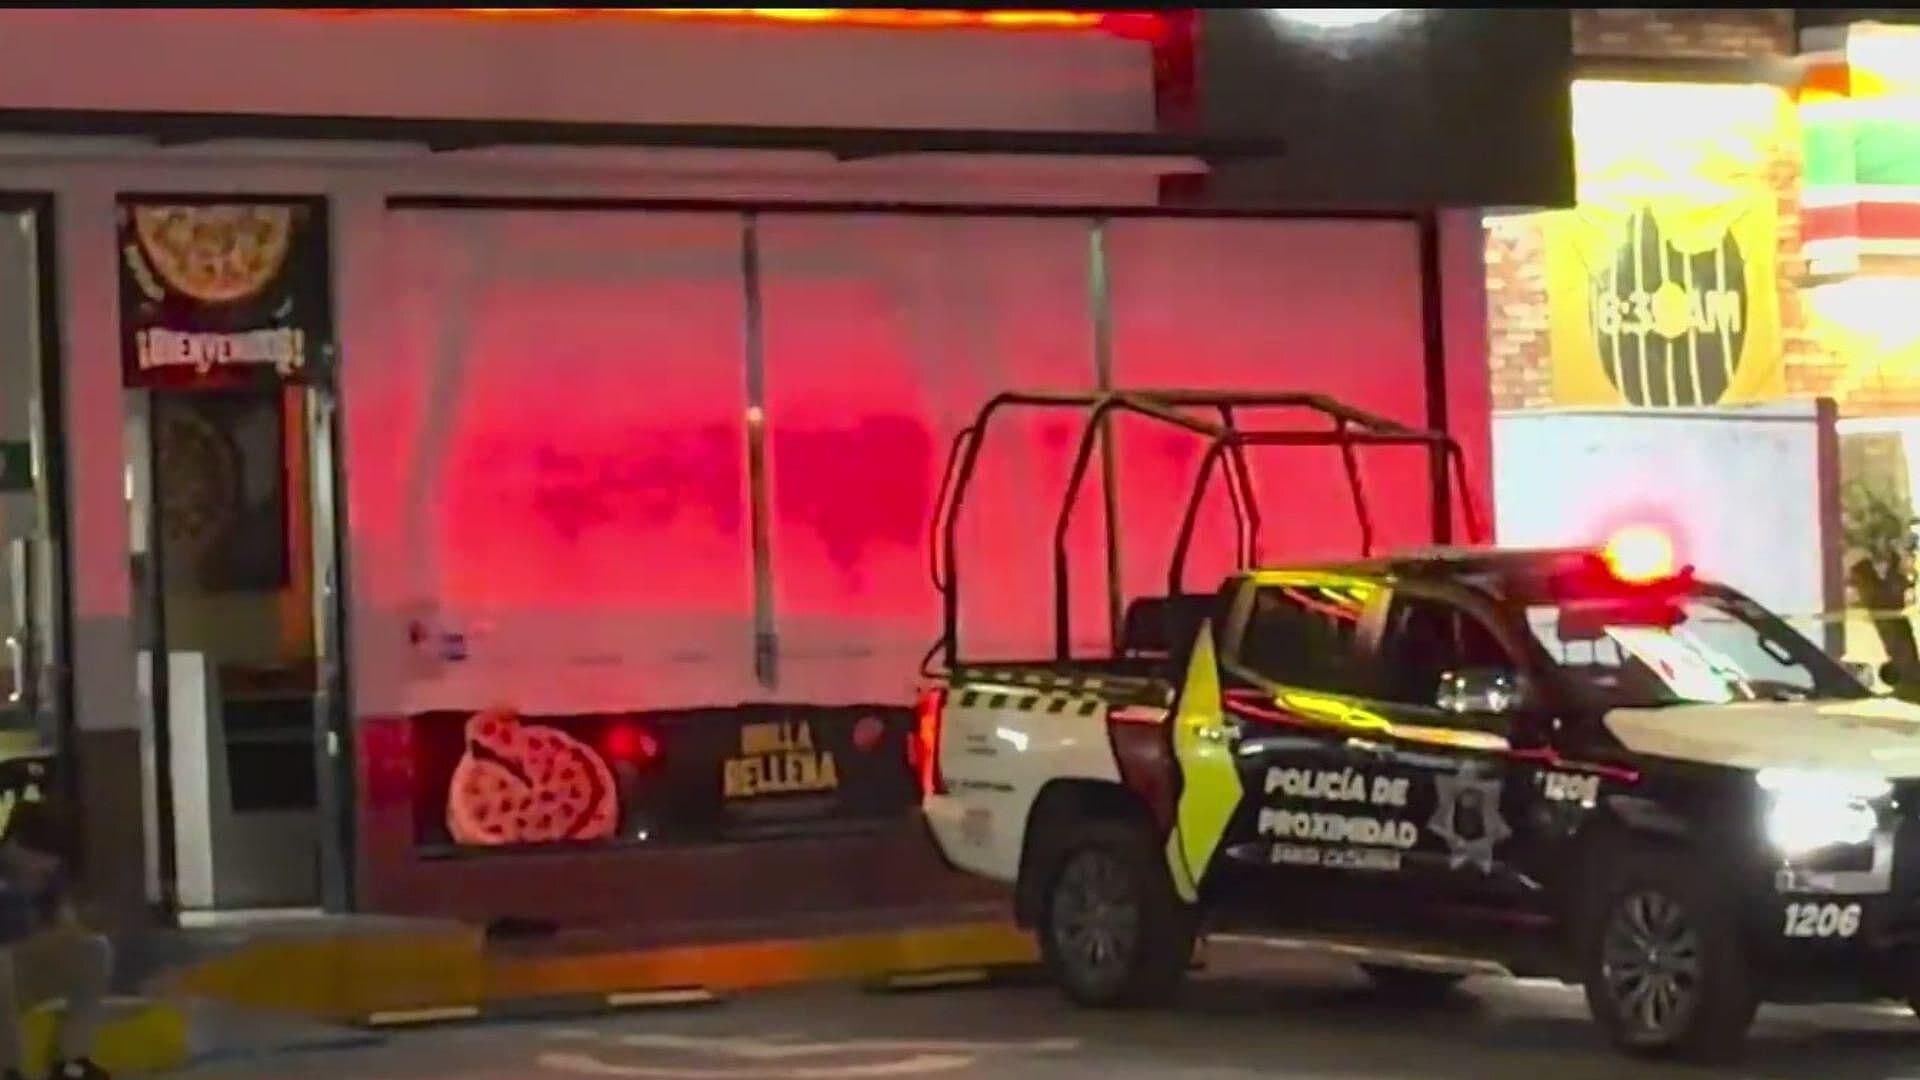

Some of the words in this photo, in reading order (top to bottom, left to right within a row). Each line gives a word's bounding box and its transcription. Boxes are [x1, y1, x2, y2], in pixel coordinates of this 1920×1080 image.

[1599, 290, 1676, 336] 8:3
[1264, 766, 1367, 802] POLICÍA
[1371, 775, 1410, 806] DE
[1258, 806, 1418, 849] PROXIMIDAD
[1784, 902, 1862, 938] 1206
